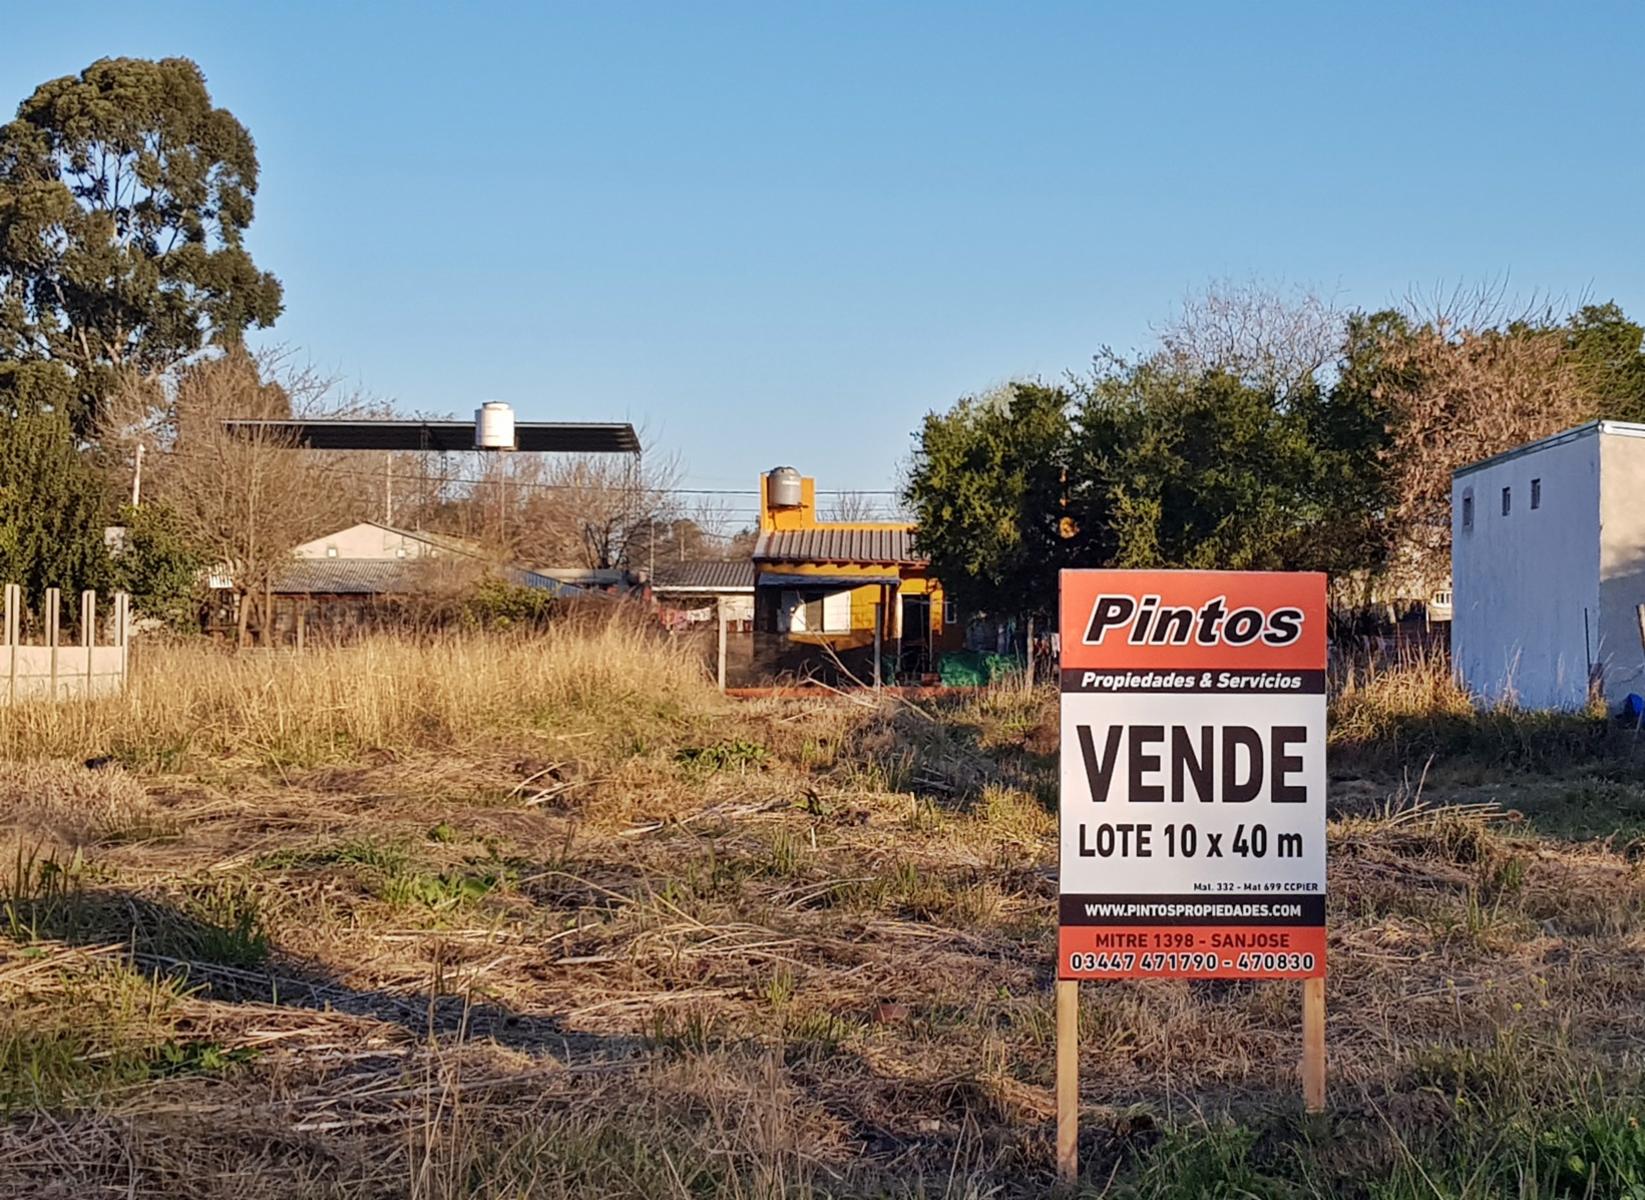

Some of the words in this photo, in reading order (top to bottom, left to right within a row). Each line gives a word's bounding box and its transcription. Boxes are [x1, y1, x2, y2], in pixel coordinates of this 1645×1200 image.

[1082, 594, 1305, 647] Pintos
[1082, 672, 1195, 690] Propiedades
[1199, 674, 1213, 689] &
[1217, 673, 1302, 689] Servicios
[1076, 725, 1308, 803] VENDE
[1079, 824, 1152, 858] LOTE
[1164, 824, 1197, 858] 10
[1206, 833, 1224, 858] x
[1232, 824, 1268, 858] 40
[1277, 833, 1303, 858] m
[1216, 882, 1235, 892] 332
[1243, 882, 1262, 892] Mat
[1263, 882, 1282, 892] 699
[1084, 903, 1302, 918] WWW.PINTOSPROPIEDADES.COM
[1095, 933, 1148, 948] MITRE
[1153, 933, 1194, 948] 1398
[1069, 952, 1136, 972] 03447
[1139, 952, 1218, 972] 471790
[1237, 953, 1315, 972] 470830
